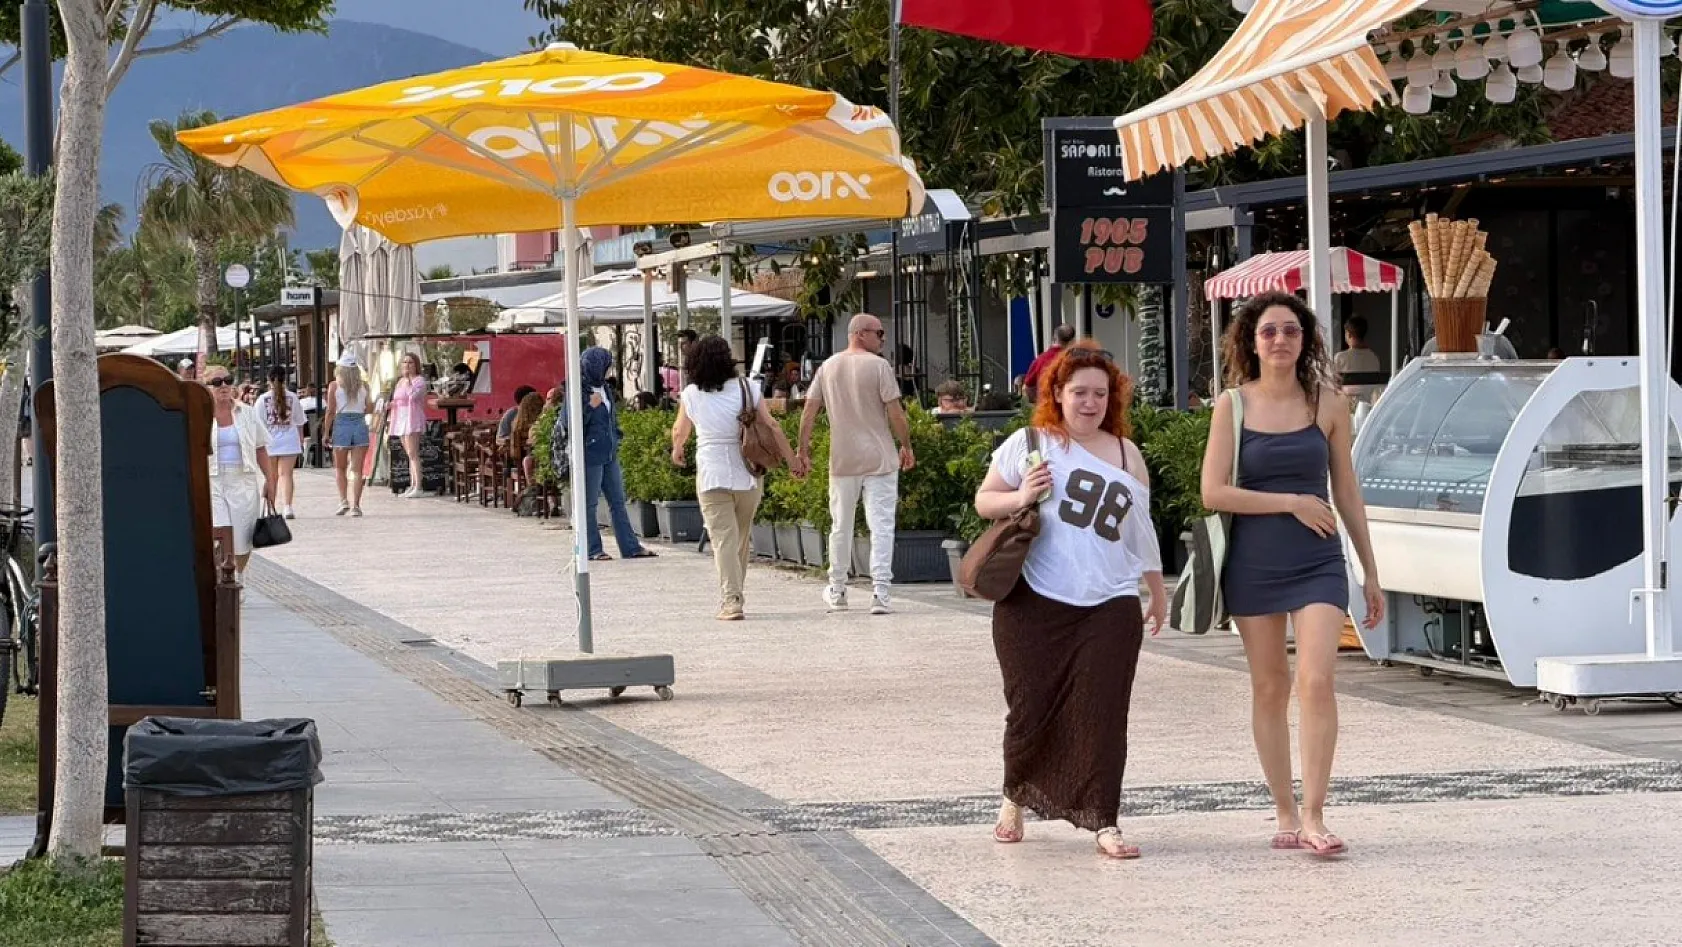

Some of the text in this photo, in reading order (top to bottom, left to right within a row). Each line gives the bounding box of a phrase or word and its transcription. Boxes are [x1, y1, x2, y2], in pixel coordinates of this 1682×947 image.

[385, 71, 666, 105] %100
[1061, 144, 1112, 158] SAPORI
[1087, 166, 1124, 178] Ristora
[1080, 217, 1149, 246] 1905
[1084, 246, 1145, 274] PUB
[1058, 467, 1133, 542] 98
